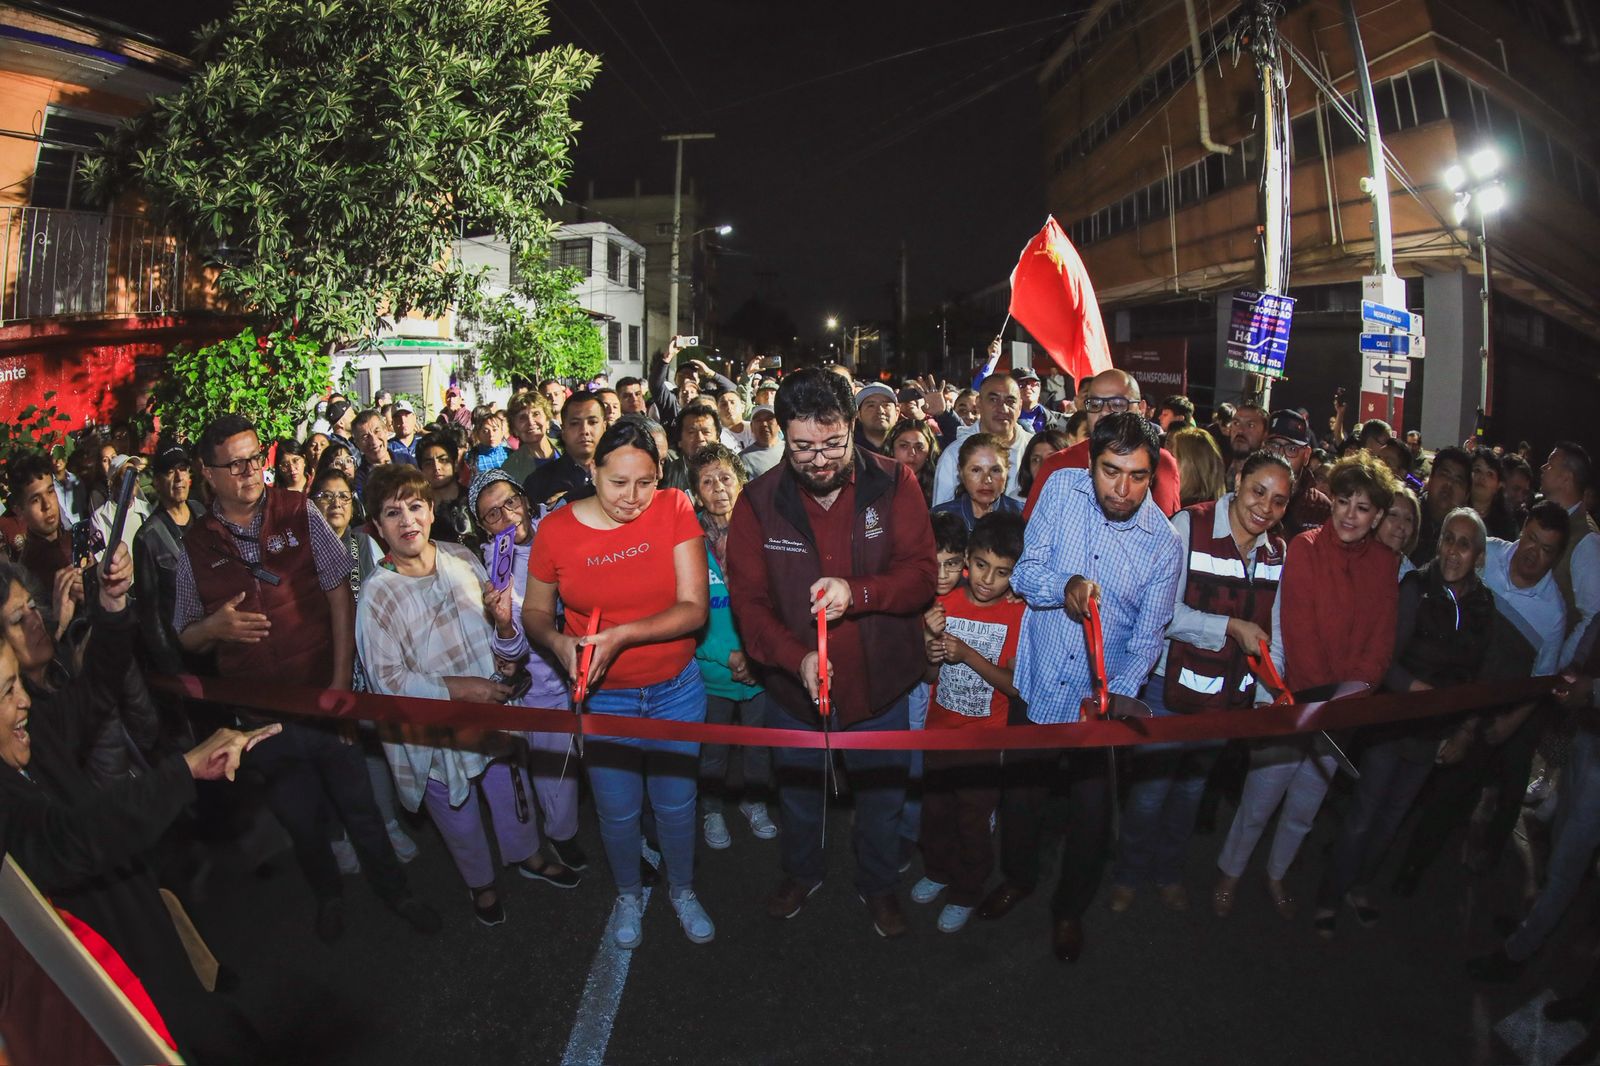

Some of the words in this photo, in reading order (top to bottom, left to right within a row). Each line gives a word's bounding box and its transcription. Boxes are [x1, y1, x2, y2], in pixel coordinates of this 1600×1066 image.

[1263, 299, 1292, 311] VENTA
[1249, 305, 1291, 319] PROPIEDAD
[1235, 330, 1252, 343] H4
[1267, 358, 1281, 368] mts
[1136, 371, 1181, 384] TRANSFORMAN
[587, 543, 650, 567] MANGO
[957, 620, 965, 631] TO
[967, 622, 975, 632] DO
[977, 624, 990, 635] LIST
